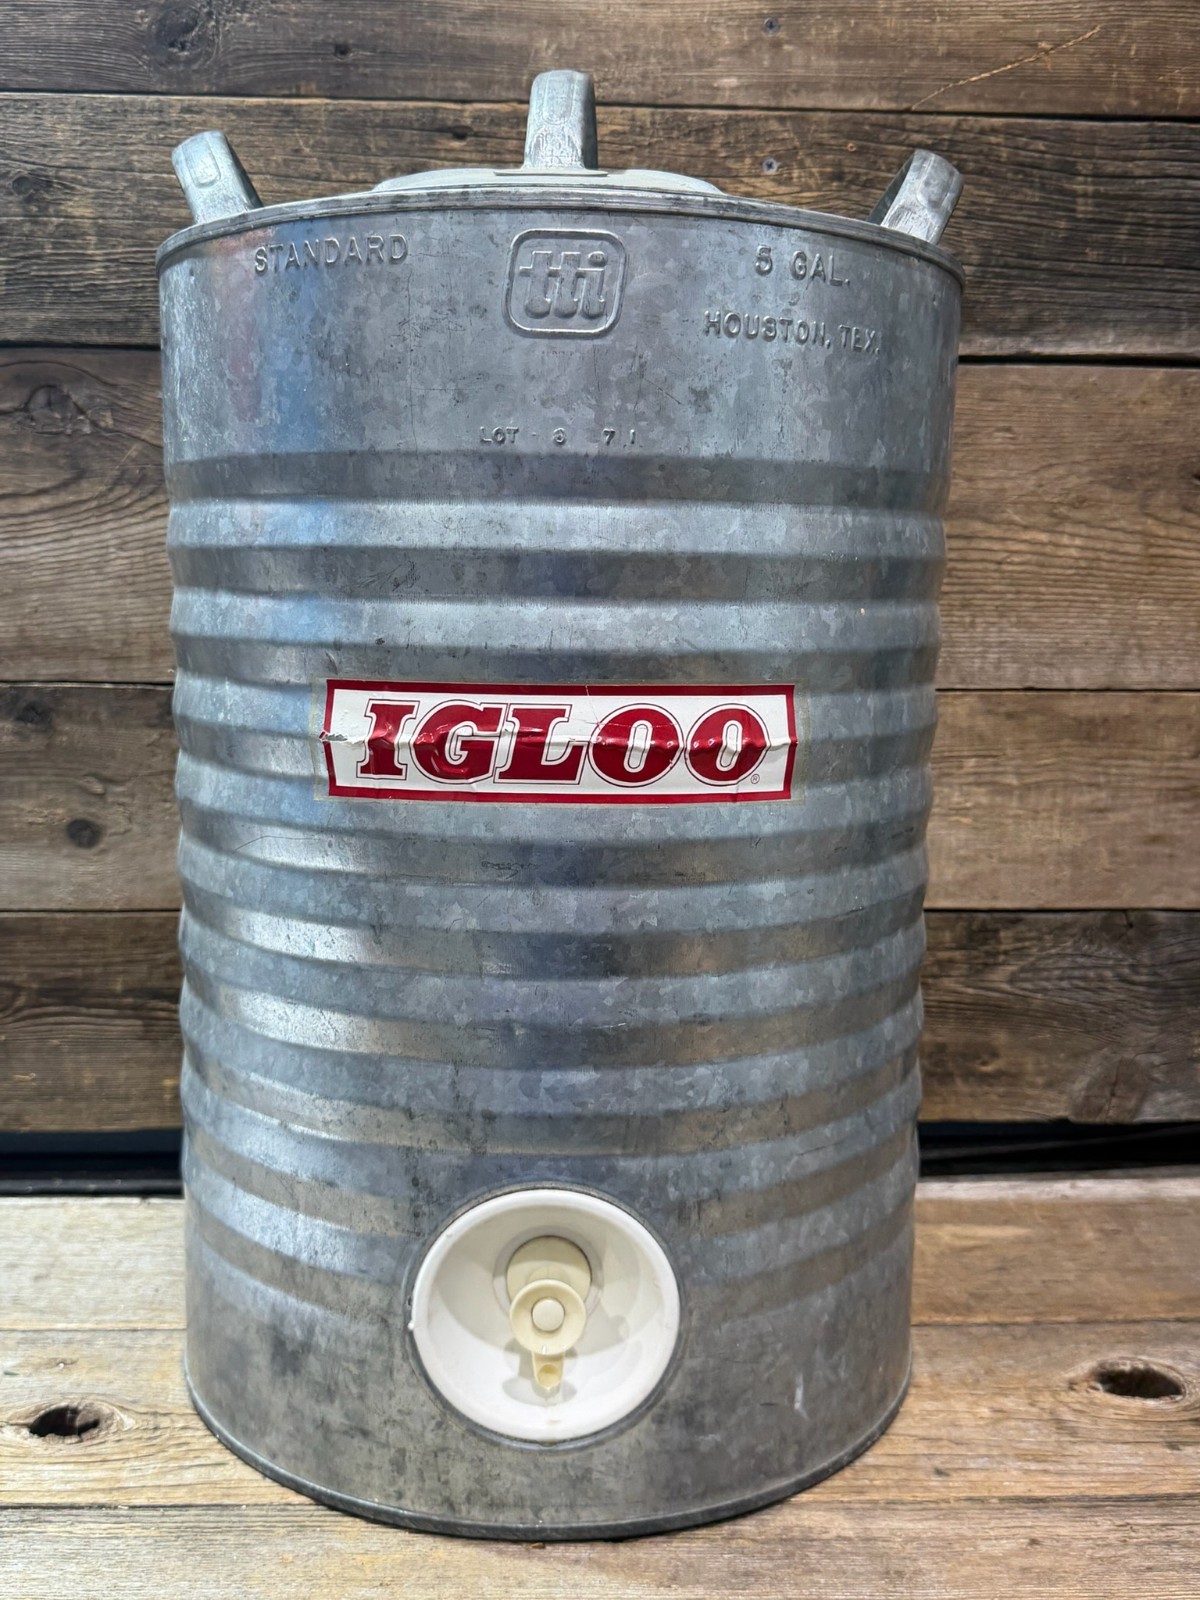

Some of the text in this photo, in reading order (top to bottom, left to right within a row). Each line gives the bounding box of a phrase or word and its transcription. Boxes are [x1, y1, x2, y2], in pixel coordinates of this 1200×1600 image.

[254, 233, 409, 274] STANDARD
[754, 244, 850, 286] 5 GAL.
[479, 426, 520, 445] LOT
[356, 699, 772, 788] IGLOO
